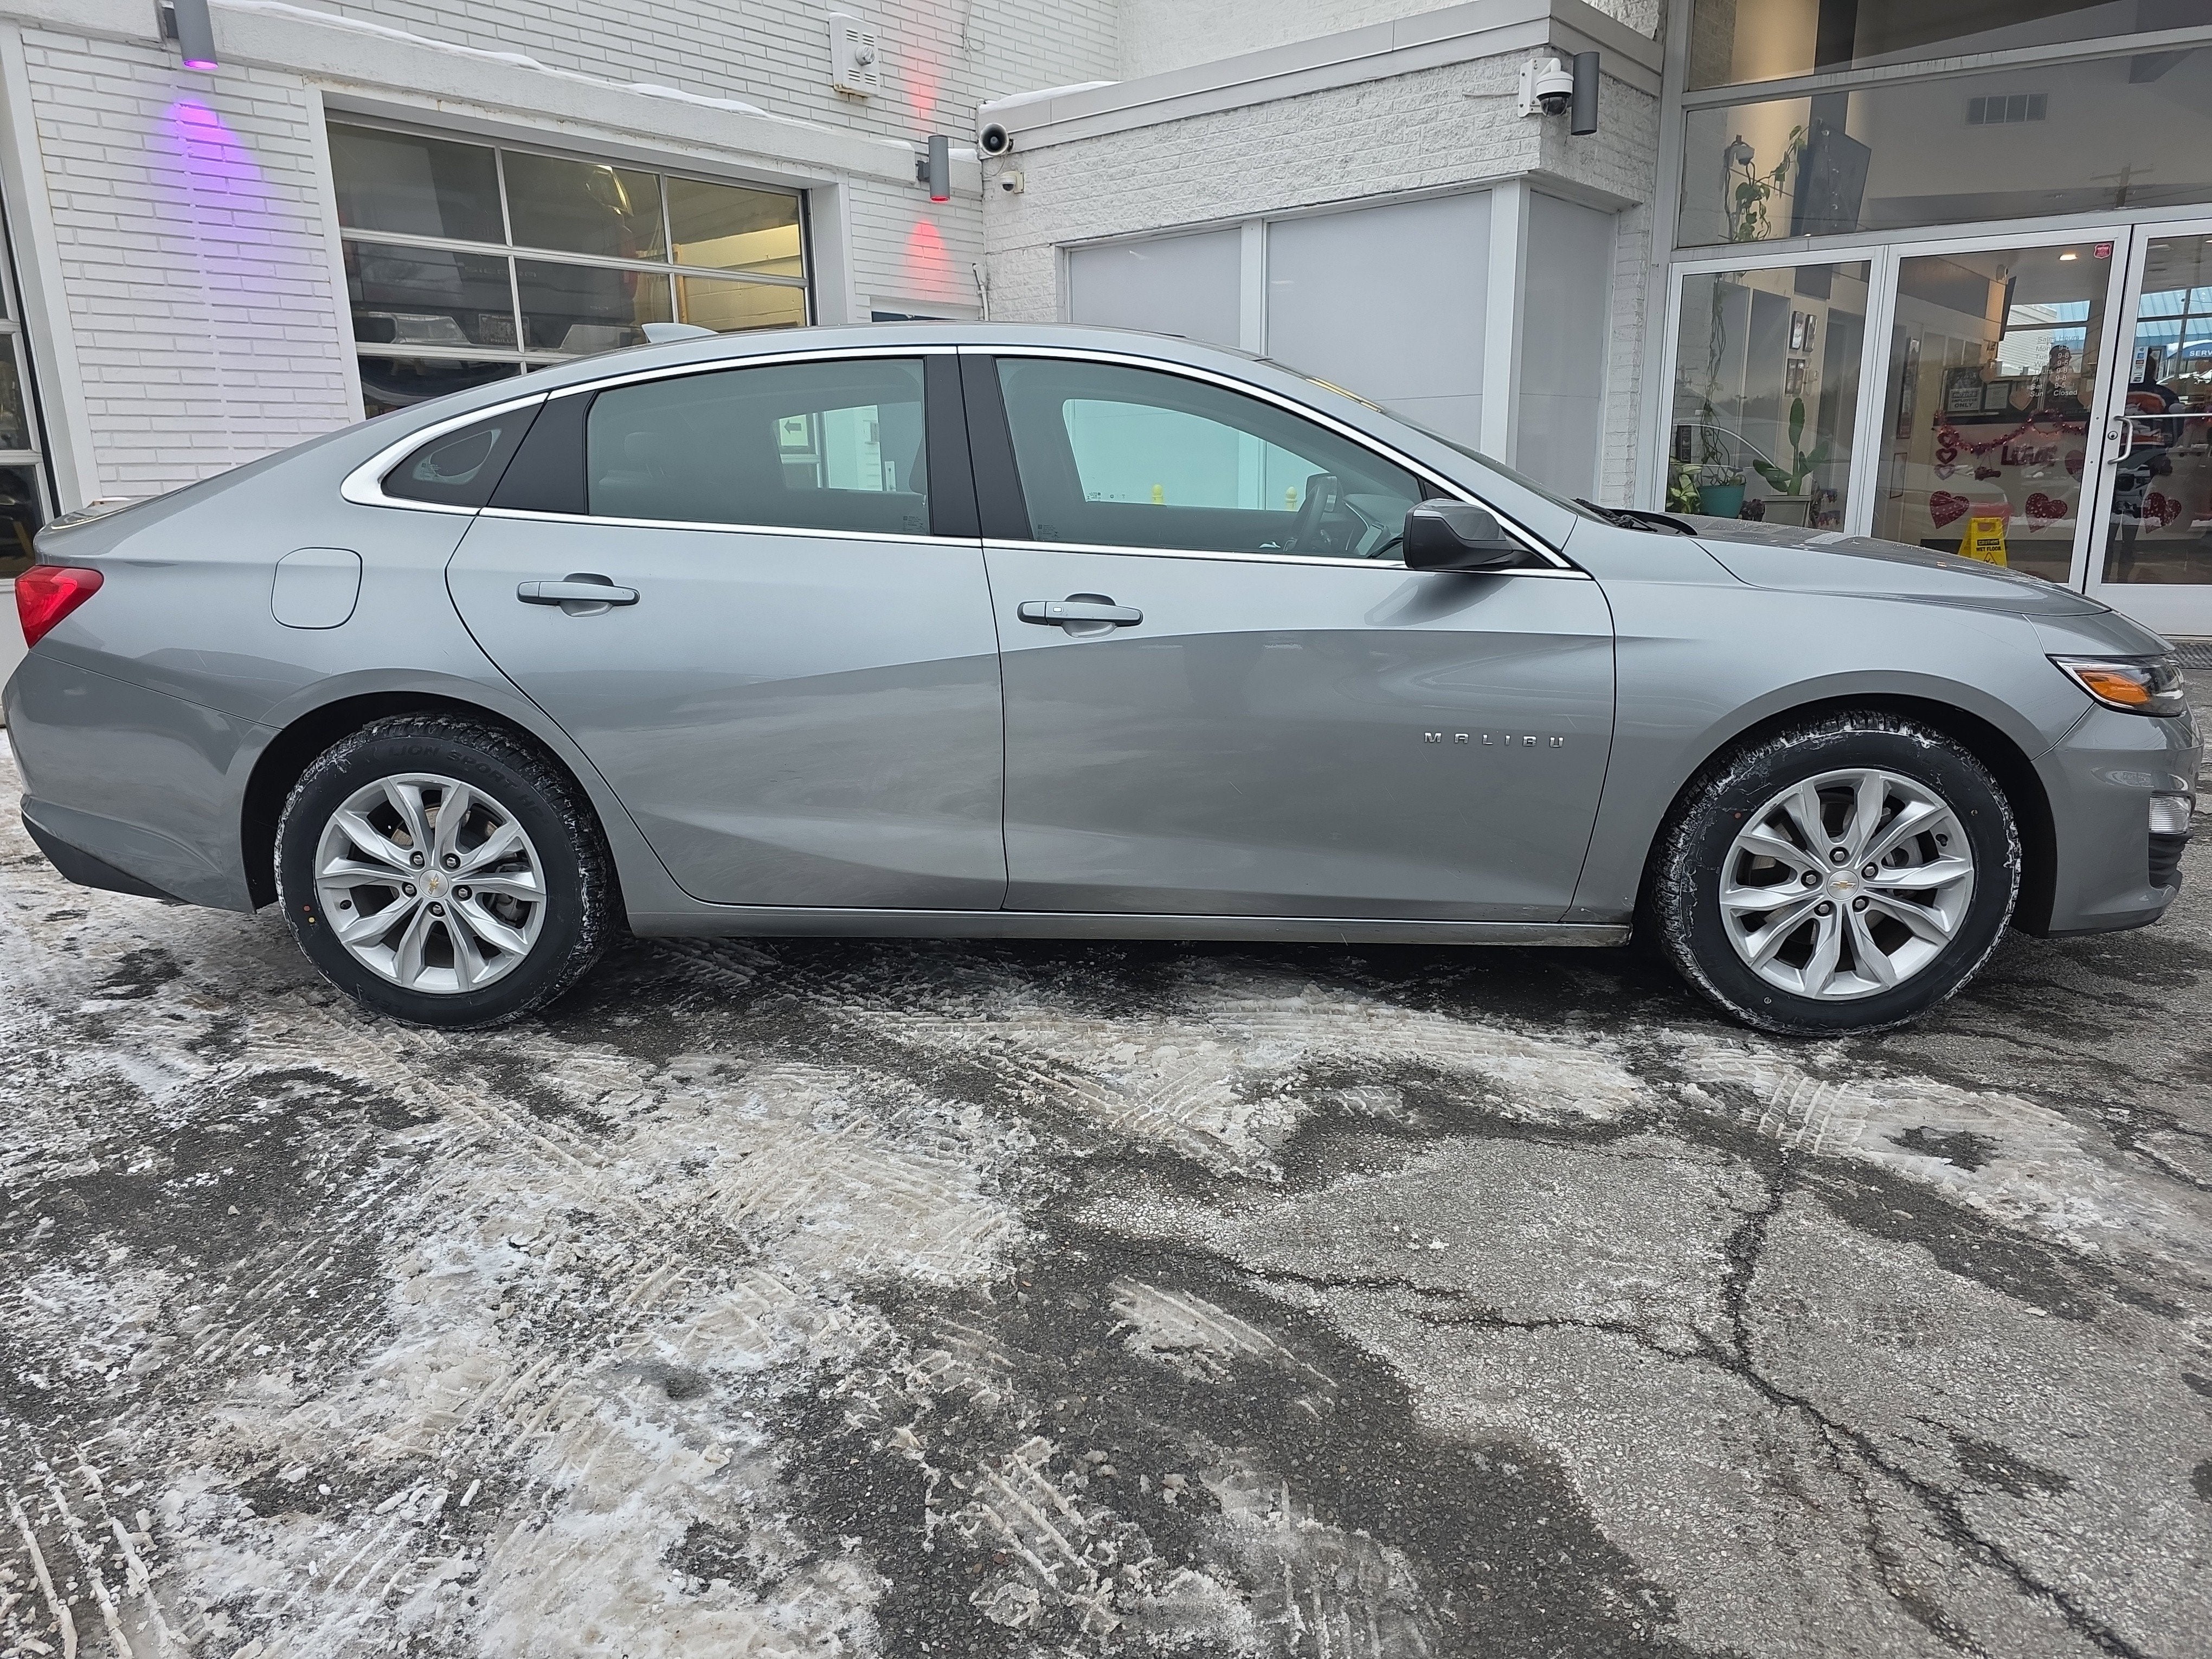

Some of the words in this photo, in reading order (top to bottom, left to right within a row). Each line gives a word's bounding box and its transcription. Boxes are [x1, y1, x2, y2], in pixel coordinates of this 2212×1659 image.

[1424, 732, 1564, 748] MALIBU
[389, 745, 440, 757] LION
[447, 750, 518, 789] SPORT
